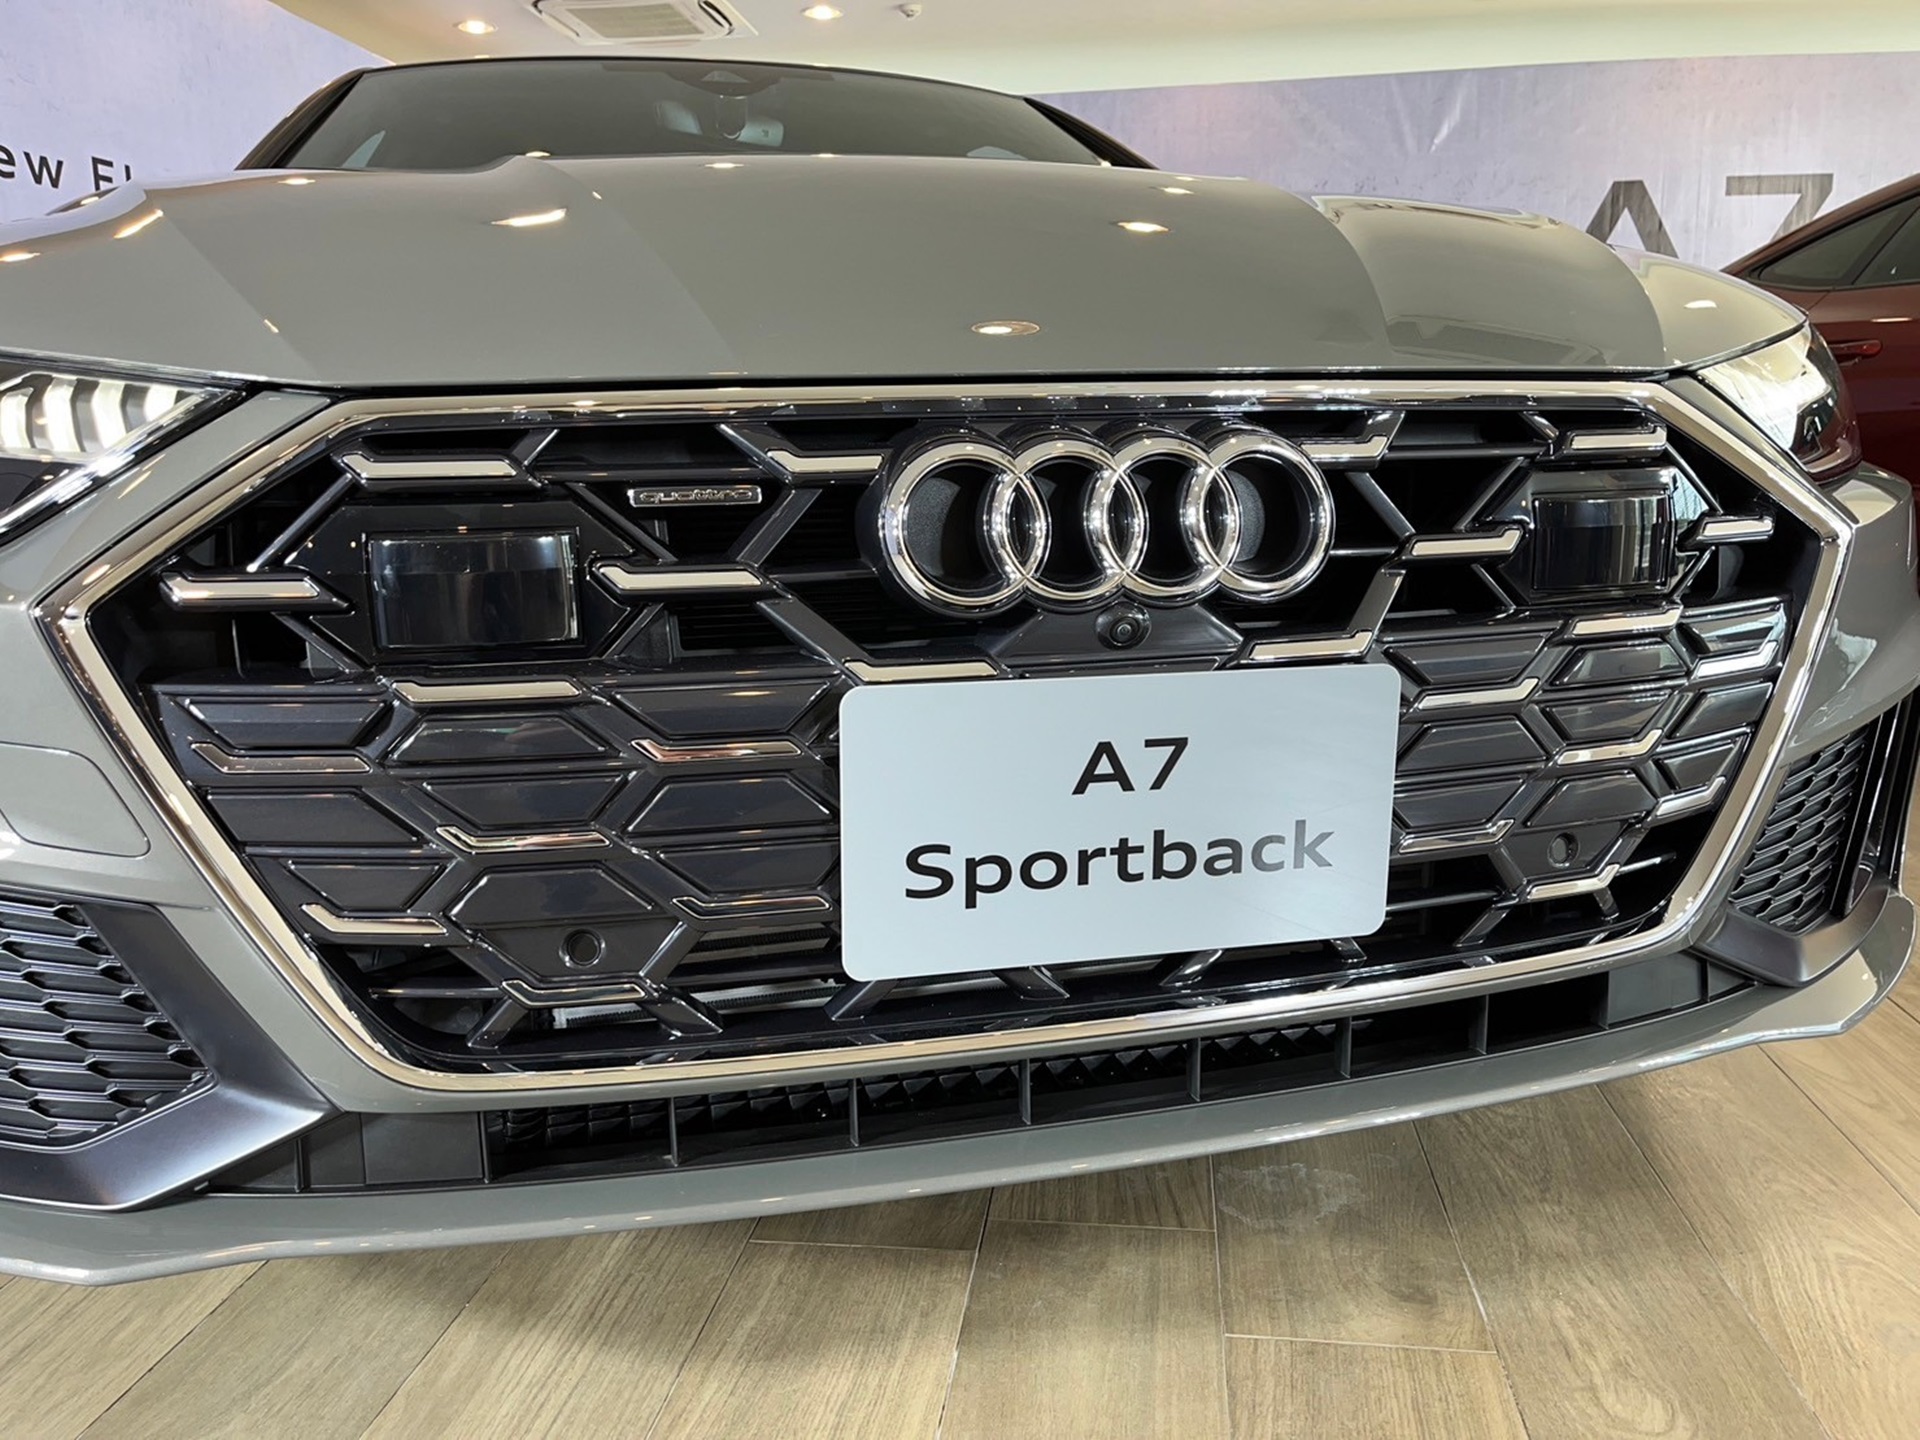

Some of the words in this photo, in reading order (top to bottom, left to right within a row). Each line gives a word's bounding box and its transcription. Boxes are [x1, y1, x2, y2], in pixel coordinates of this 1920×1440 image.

[1585, 173, 1834, 259] A7
[640, 489, 752, 504] quattro
[1071, 737, 1189, 795] A7
[905, 819, 1335, 909] Sportback
